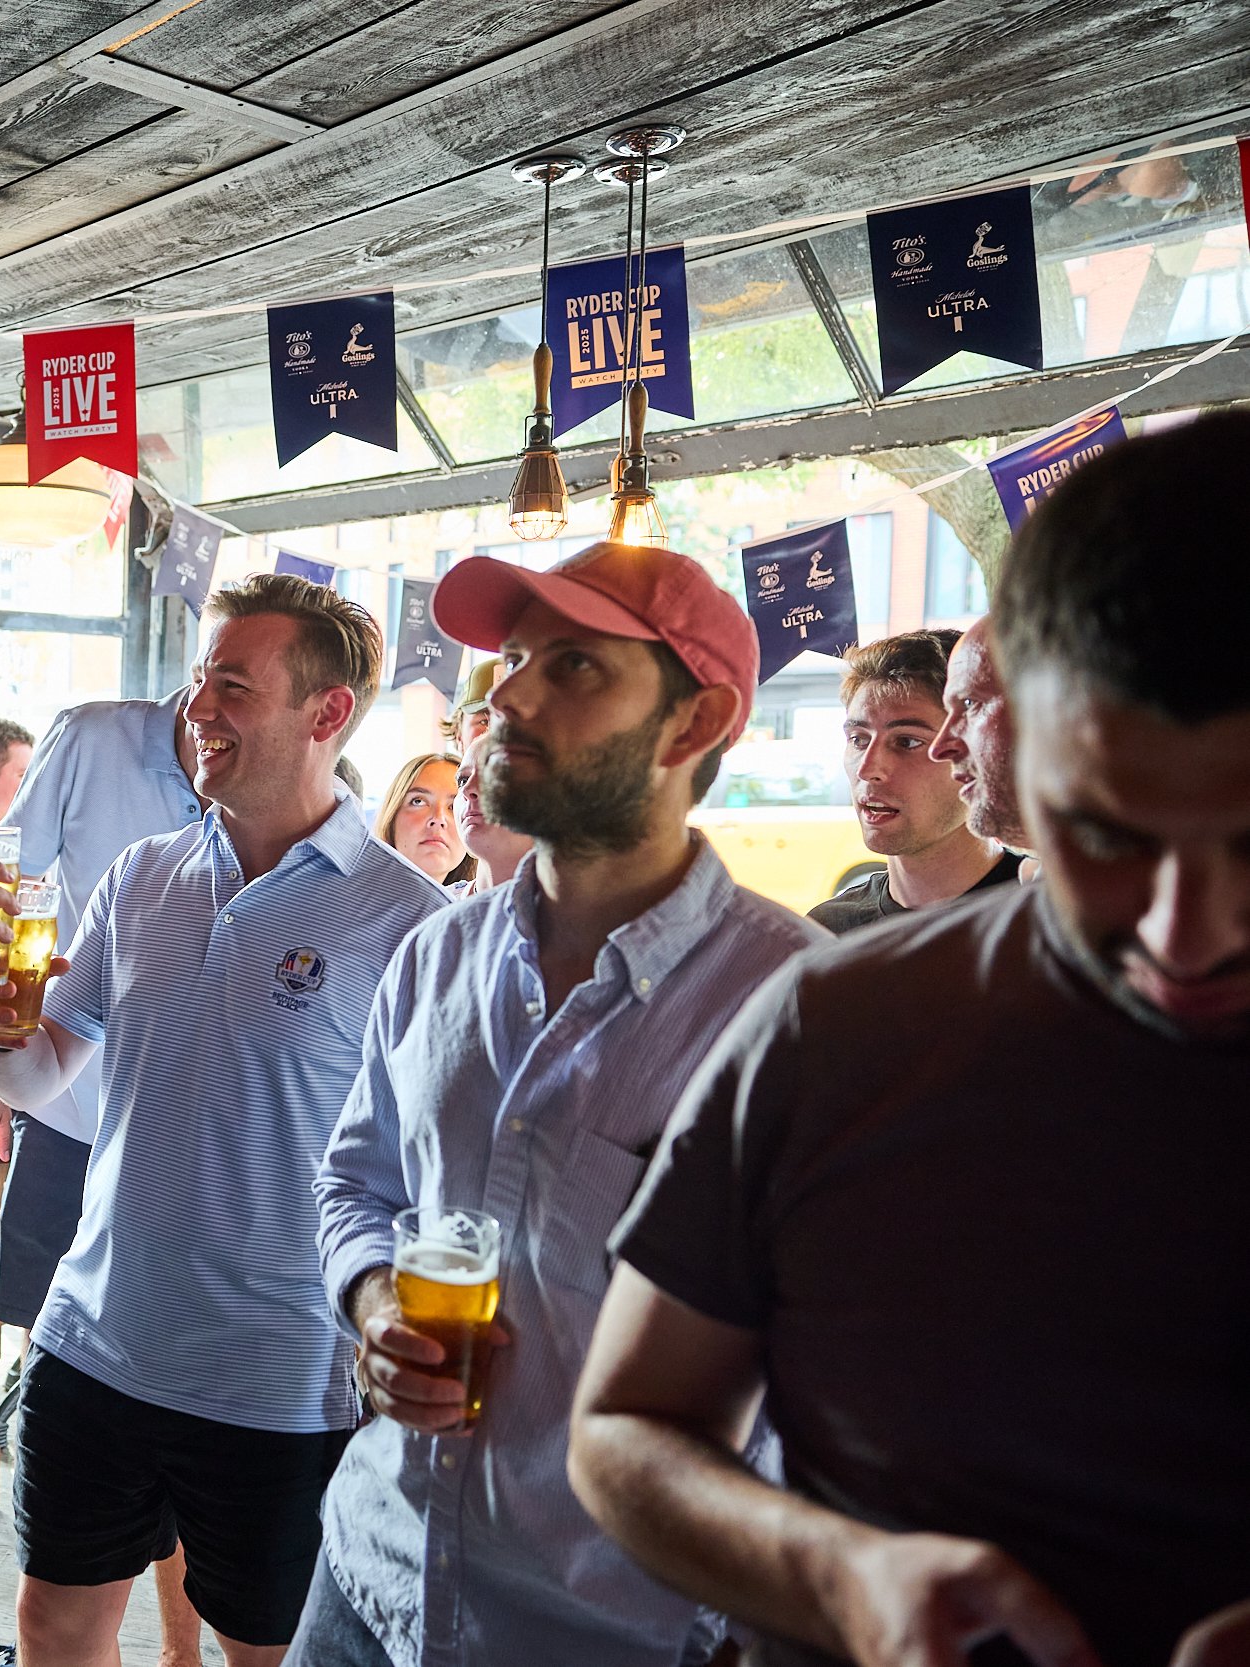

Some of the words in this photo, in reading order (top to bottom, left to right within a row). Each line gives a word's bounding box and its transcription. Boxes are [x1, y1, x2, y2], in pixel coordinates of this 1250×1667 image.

[892, 234, 926, 250] Tito's
[966, 254, 1008, 267] Goslings
[566, 291, 623, 319] RYDER
[628, 285, 661, 309] CUP
[927, 297, 989, 318] ULTRA
[285, 330, 312, 343] Tito's
[568, 308, 665, 374] LIVE
[580, 328, 590, 354] 2025
[42, 355, 86, 377] RYDER
[88, 352, 116, 371] CUP
[341, 353, 375, 362] Goslings
[578, 374, 617, 384] WATCH
[43, 373, 117, 426] LIVE
[310, 388, 358, 405] ULTRA
[50, 429, 79, 437] WATCH
[1016, 459, 1072, 497] RYDER
[781, 609, 824, 628] ULTRA
[416, 645, 443, 658] ULTRA
